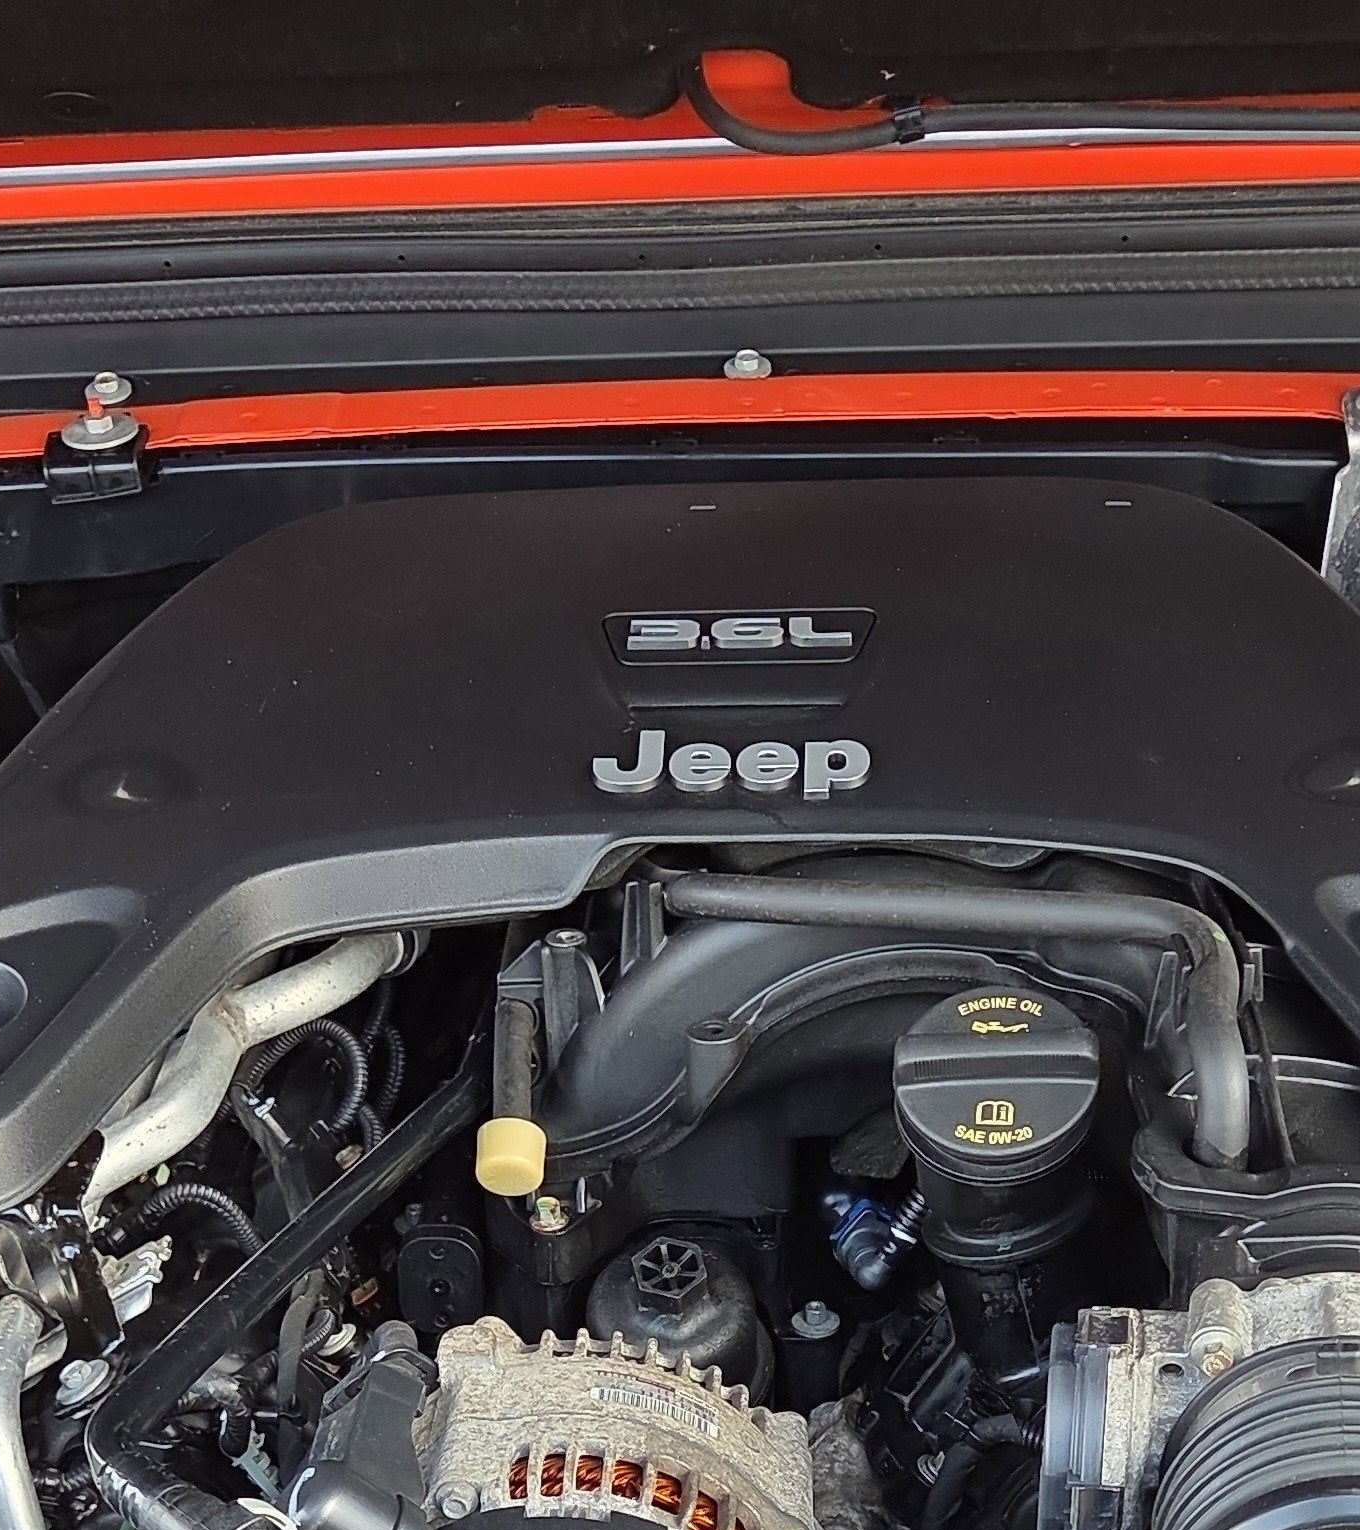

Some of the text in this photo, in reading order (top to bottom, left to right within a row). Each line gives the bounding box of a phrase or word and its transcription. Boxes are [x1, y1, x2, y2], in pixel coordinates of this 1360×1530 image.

[626, 616, 853, 651] 3.6L
[592, 729, 871, 801] Jeep
[957, 997, 1044, 1017] ENGINE OIL
[954, 1124, 1034, 1145] SAE 0W-20
